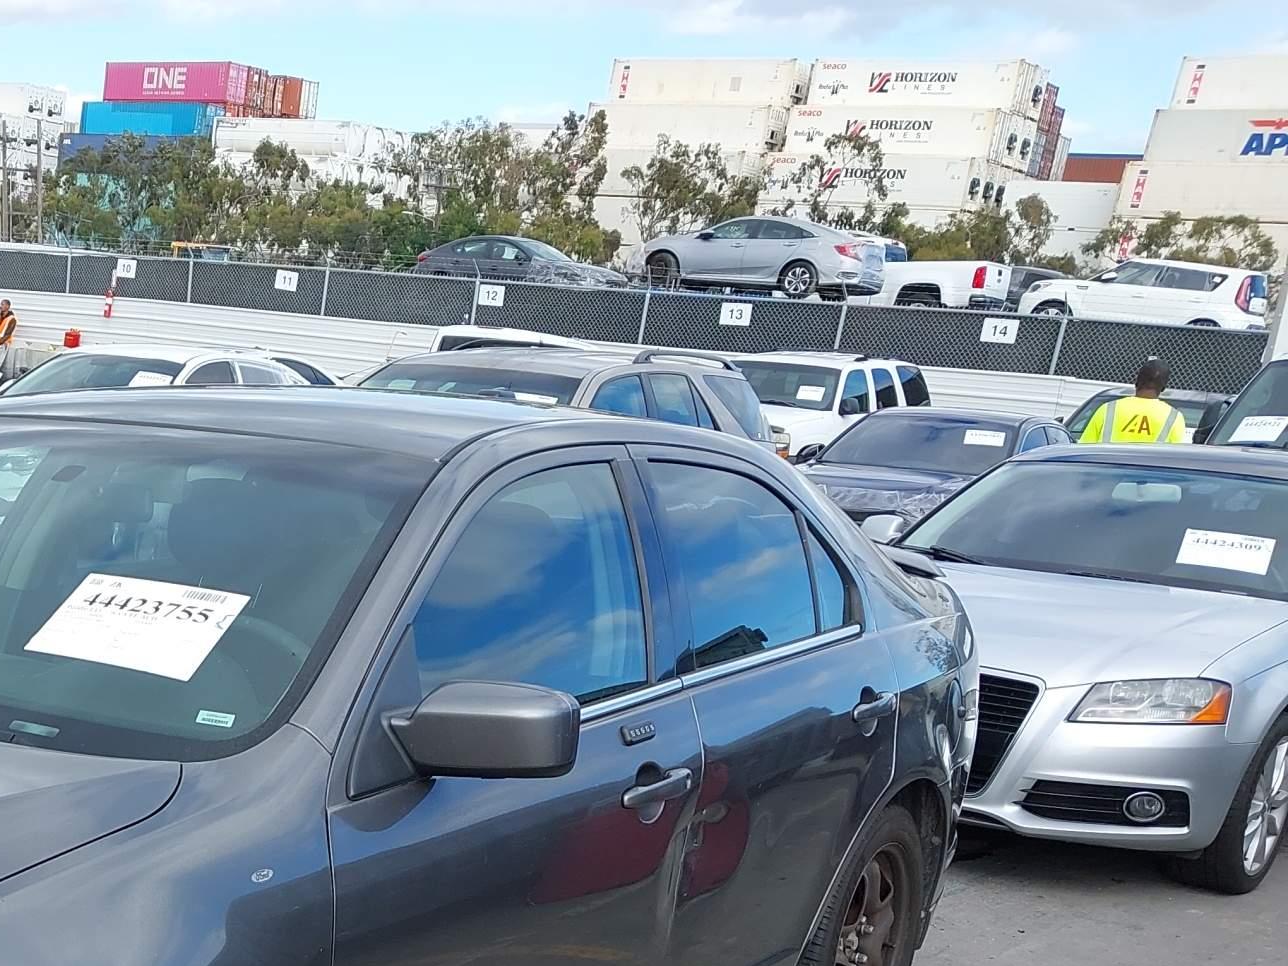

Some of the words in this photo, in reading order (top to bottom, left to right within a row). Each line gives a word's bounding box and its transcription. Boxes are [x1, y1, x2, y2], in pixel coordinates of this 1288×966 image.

[143, 67, 188, 89] ONE
[894, 72, 958, 83] HORIZON
[797, 109, 822, 117] seaco
[869, 119, 933, 131] HORIZON
[1240, 132, 1288, 156] AP
[772, 156, 797, 164] seaco
[121, 264, 132, 274] 10
[282, 275, 293, 286] 11
[486, 290, 499, 302] 12
[727, 309, 744, 320] 13
[991, 325, 1009, 337] 14
[83, 592, 215, 624] 44423755
